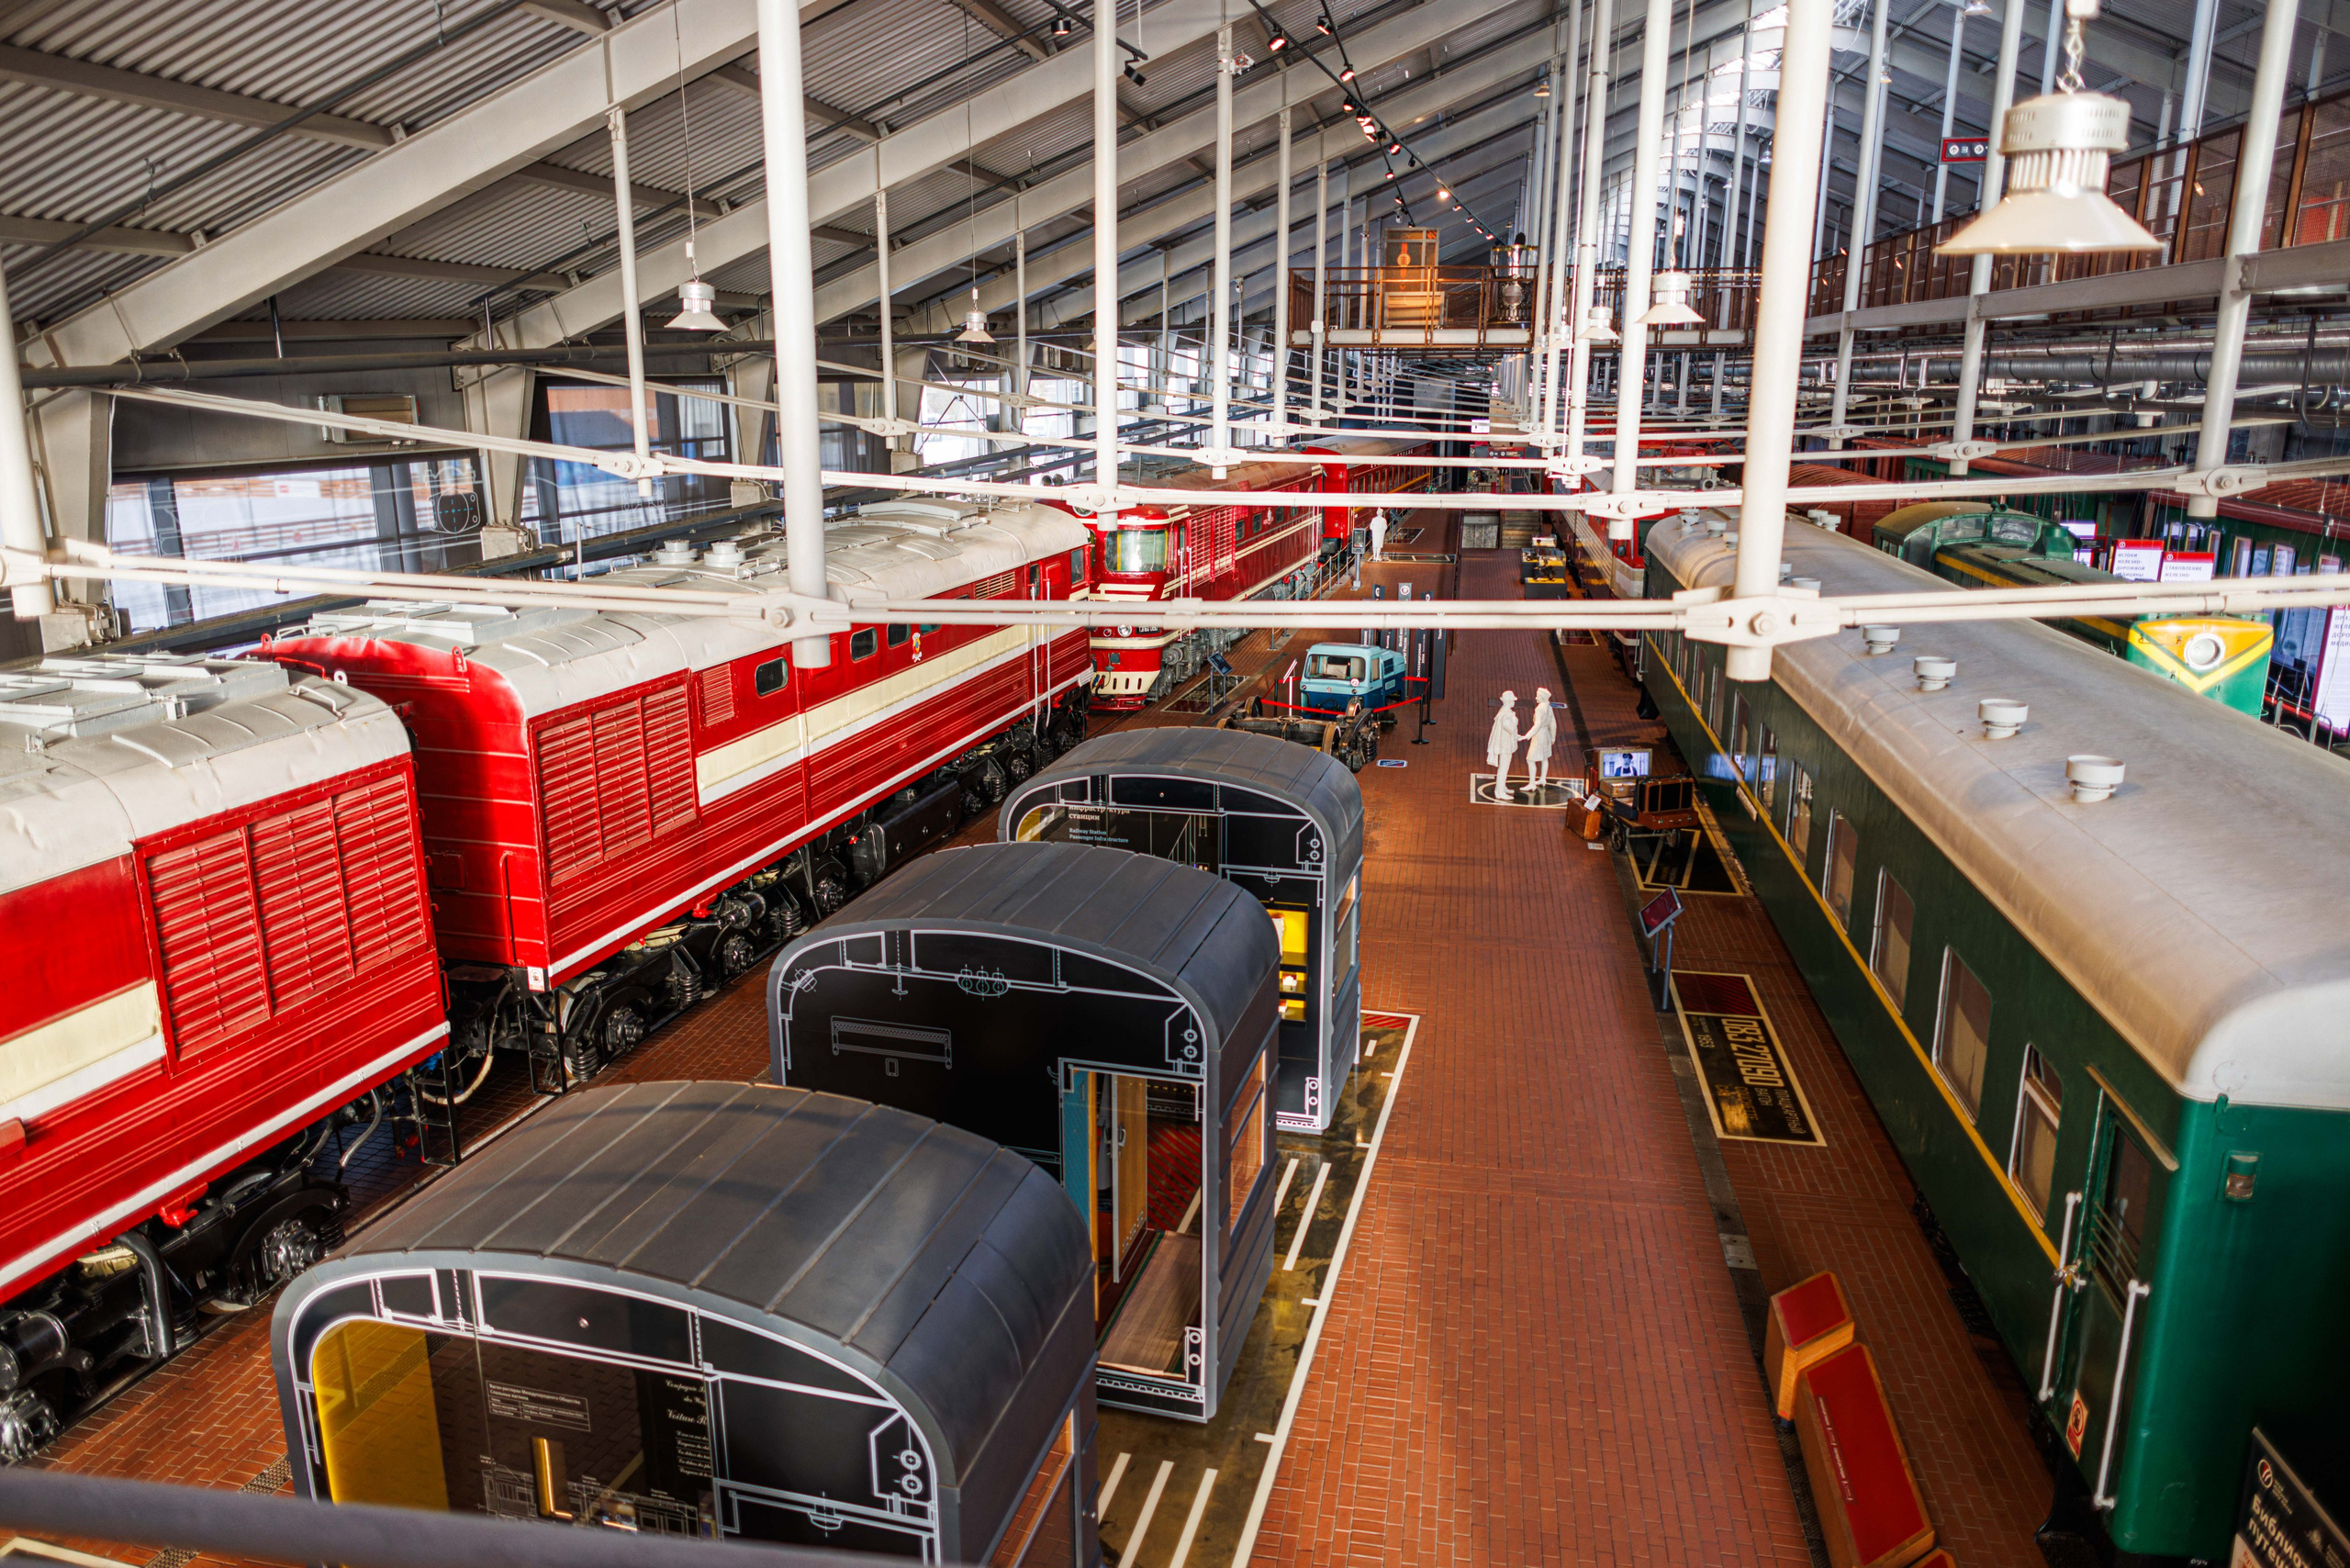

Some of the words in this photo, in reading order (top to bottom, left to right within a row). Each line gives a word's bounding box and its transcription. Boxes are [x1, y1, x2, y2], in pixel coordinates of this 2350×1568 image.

[1721, 1018, 1766, 1044] 083
[1697, 1034, 1715, 1048] 1953
[1730, 1043, 1785, 1087] 27090
[1755, 1087, 1773, 1106] ВАГОН
[1774, 1089, 1807, 1134] ПЛАЦКАРТНЫЙ
[559, 1396, 580, 1404] Общества
[667, 1409, 695, 1423] Voiture
